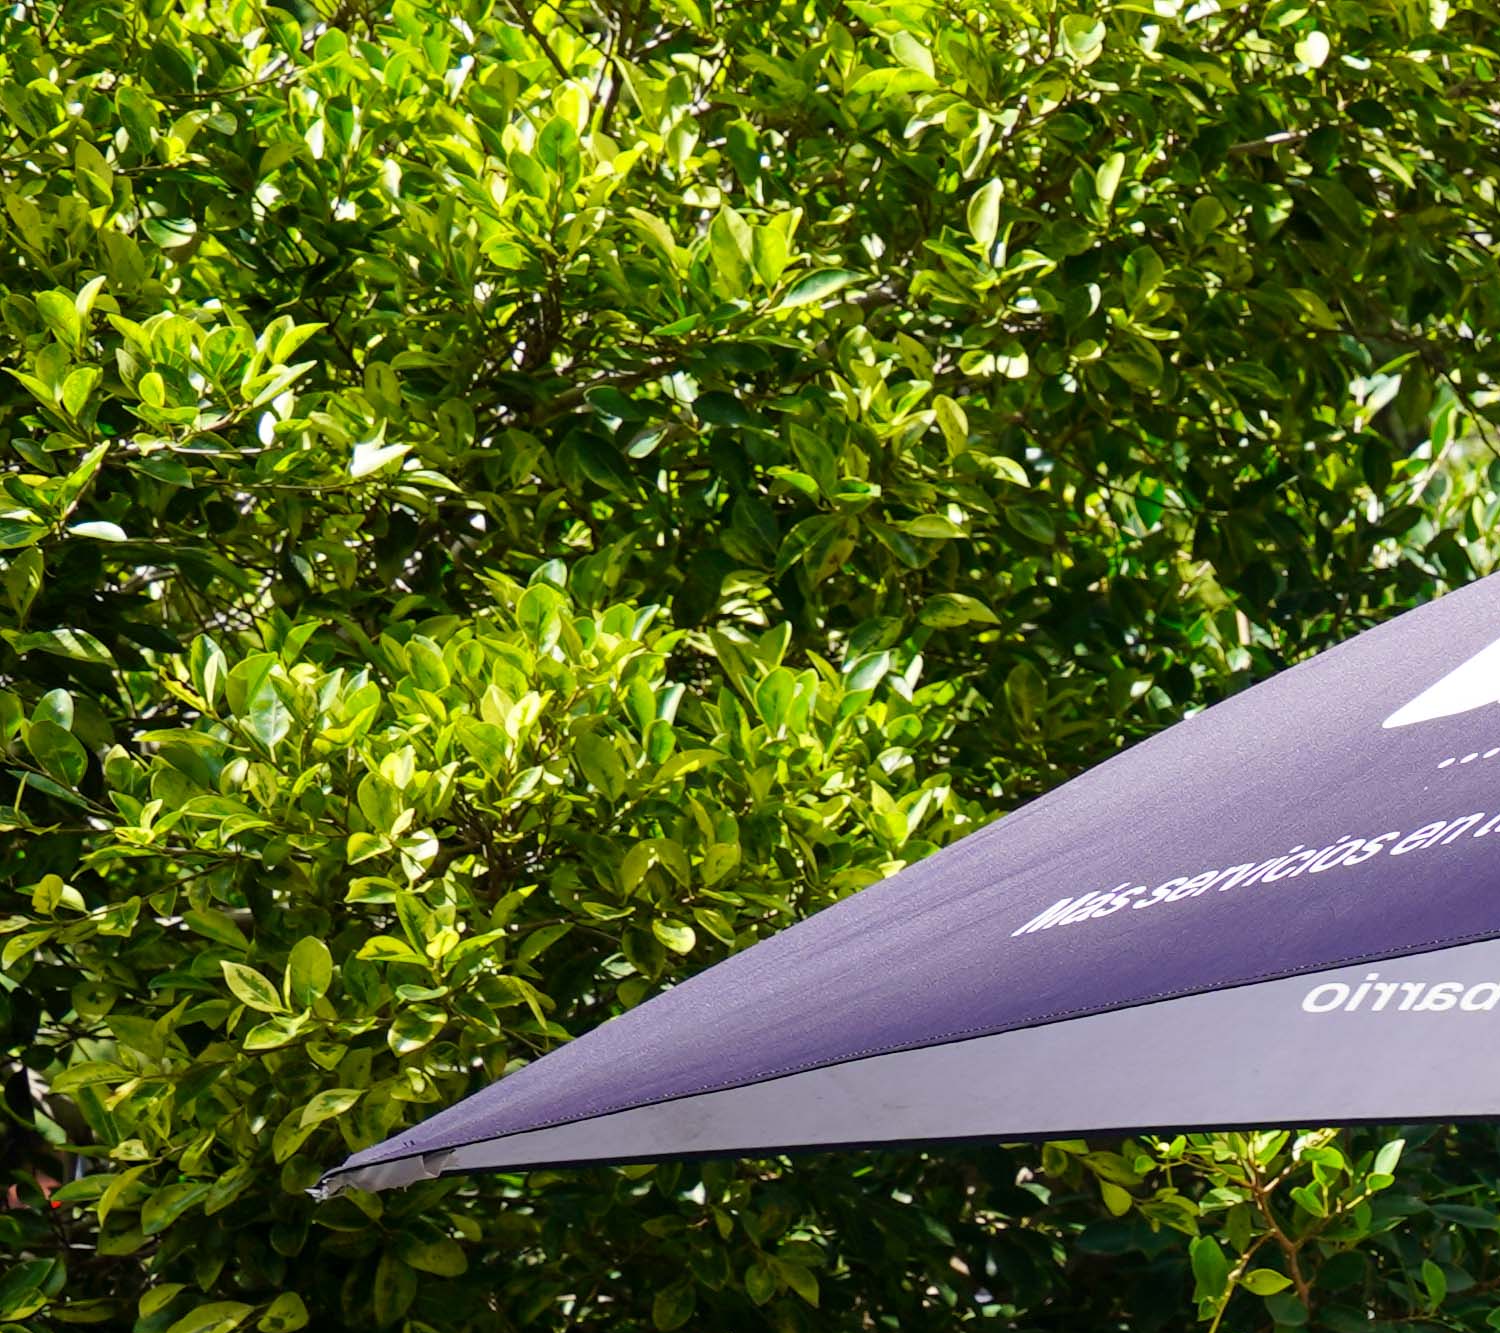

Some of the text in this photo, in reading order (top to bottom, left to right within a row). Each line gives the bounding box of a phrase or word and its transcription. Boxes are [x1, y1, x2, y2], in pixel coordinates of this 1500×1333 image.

[1010, 882, 1145, 937] Más
[1133, 830, 1400, 910] servicios
[1391, 814, 1482, 855] en
